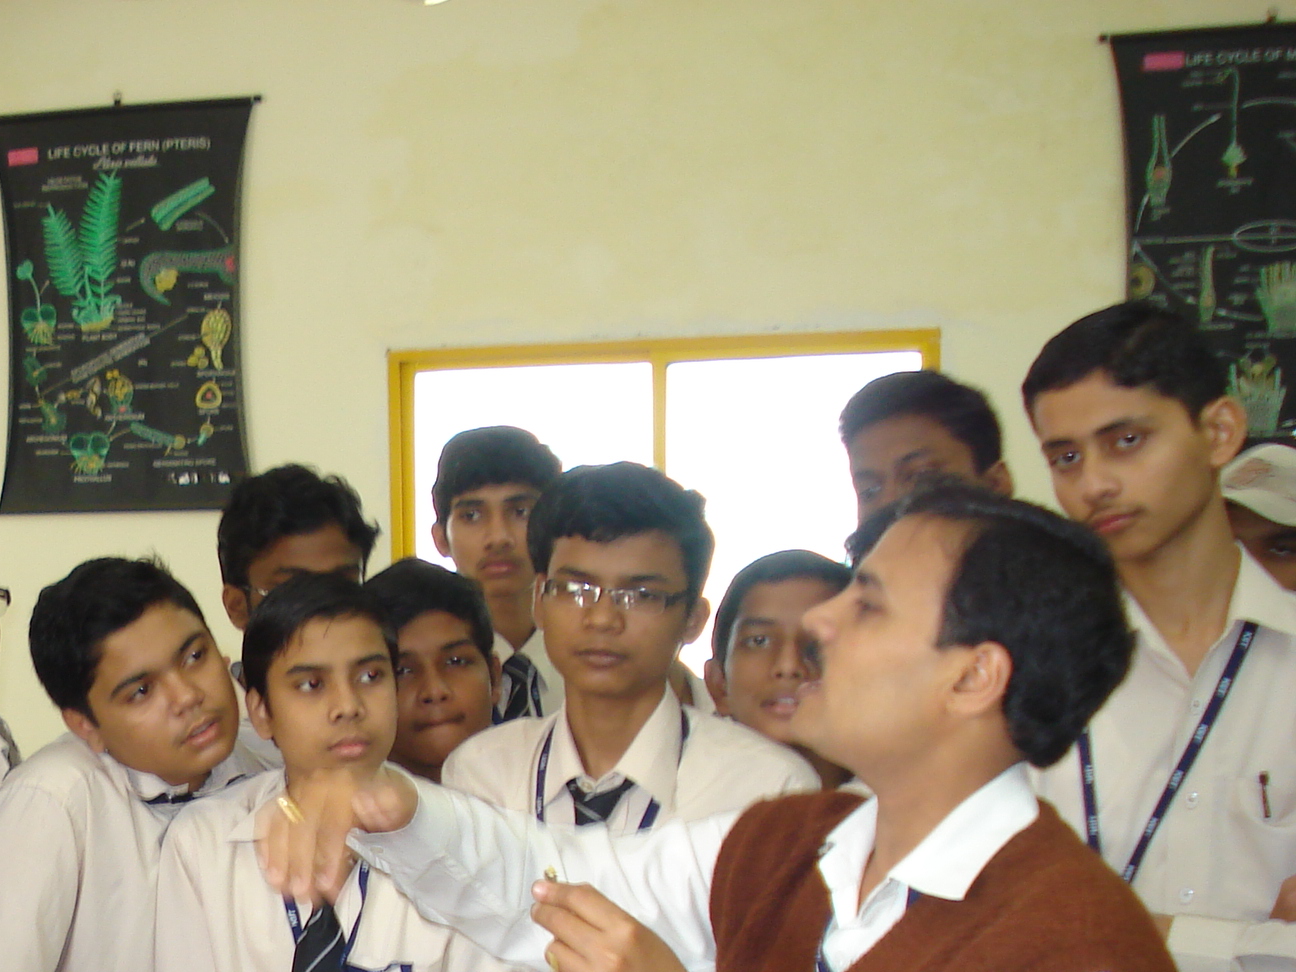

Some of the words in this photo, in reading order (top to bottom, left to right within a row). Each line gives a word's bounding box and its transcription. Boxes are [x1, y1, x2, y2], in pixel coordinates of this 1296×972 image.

[1185, 53, 1212, 67] LIFE
[1216, 50, 1261, 65] CYCLE
[1264, 49, 1283, 63] OF
[47, 146, 70, 160] LIFE
[73, 144, 111, 158] CYCLE
[112, 142, 127, 155] OF
[129, 139, 160, 153] FERN
[162, 136, 211, 152] (PTERIS)
